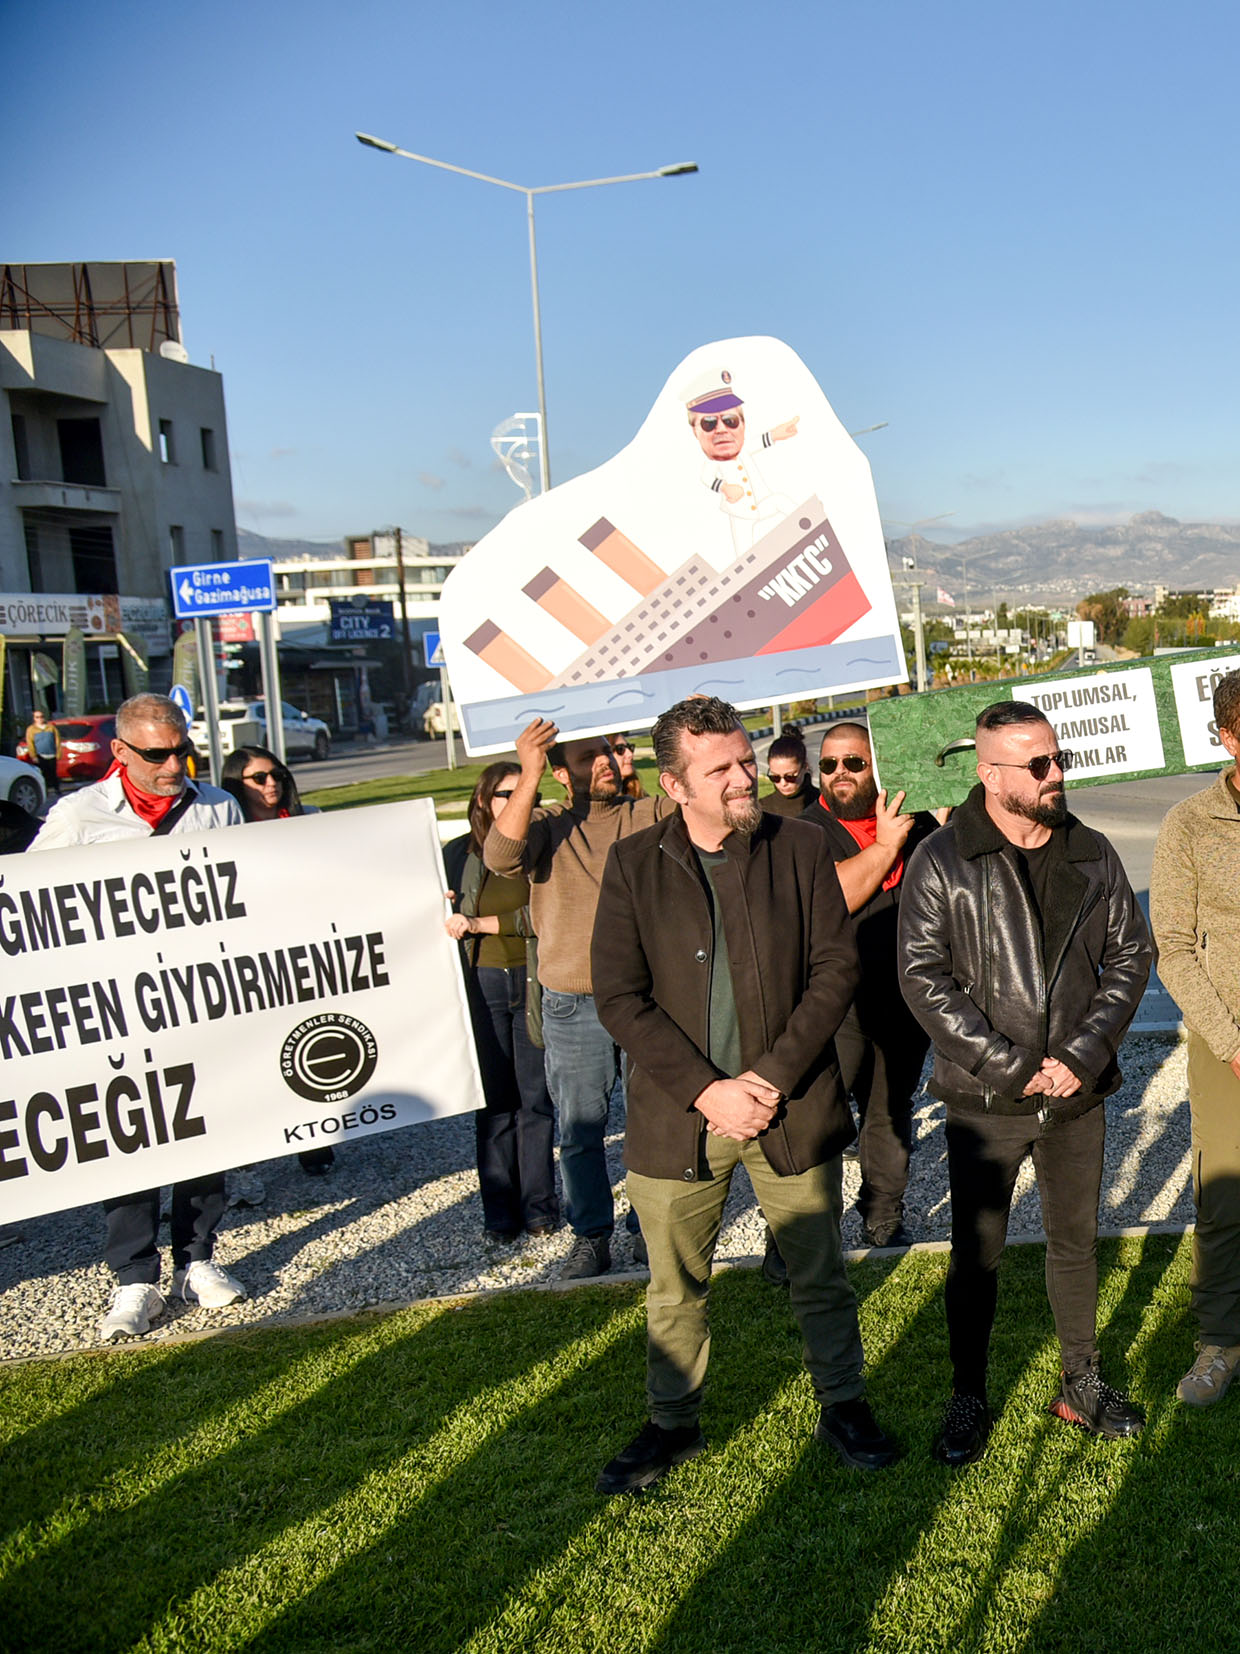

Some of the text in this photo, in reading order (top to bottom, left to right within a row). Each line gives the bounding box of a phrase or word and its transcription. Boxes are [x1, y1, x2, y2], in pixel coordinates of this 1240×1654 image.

[192, 571, 231, 587] Girne
[757, 533, 833, 608] "KKTC"
[194, 585, 270, 605] Gazimağusa
[7, 600, 69, 628] ÇÖRECİK
[340, 615, 370, 629] CITY
[380, 623, 392, 638] 2
[1030, 683, 1137, 712] TOPLUMSAL,
[0, 846, 247, 956] ĞMEYECEĞİZ
[0, 923, 391, 1060] KEFEN GİYDİRMENİZE
[282, 1014, 335, 1077] ÖĞRETMENLER
[324, 1090, 349, 1102] 1968
[0, 1048, 206, 1182] ECEĞİZ
[284, 1103, 397, 1144] KTOEÖS
